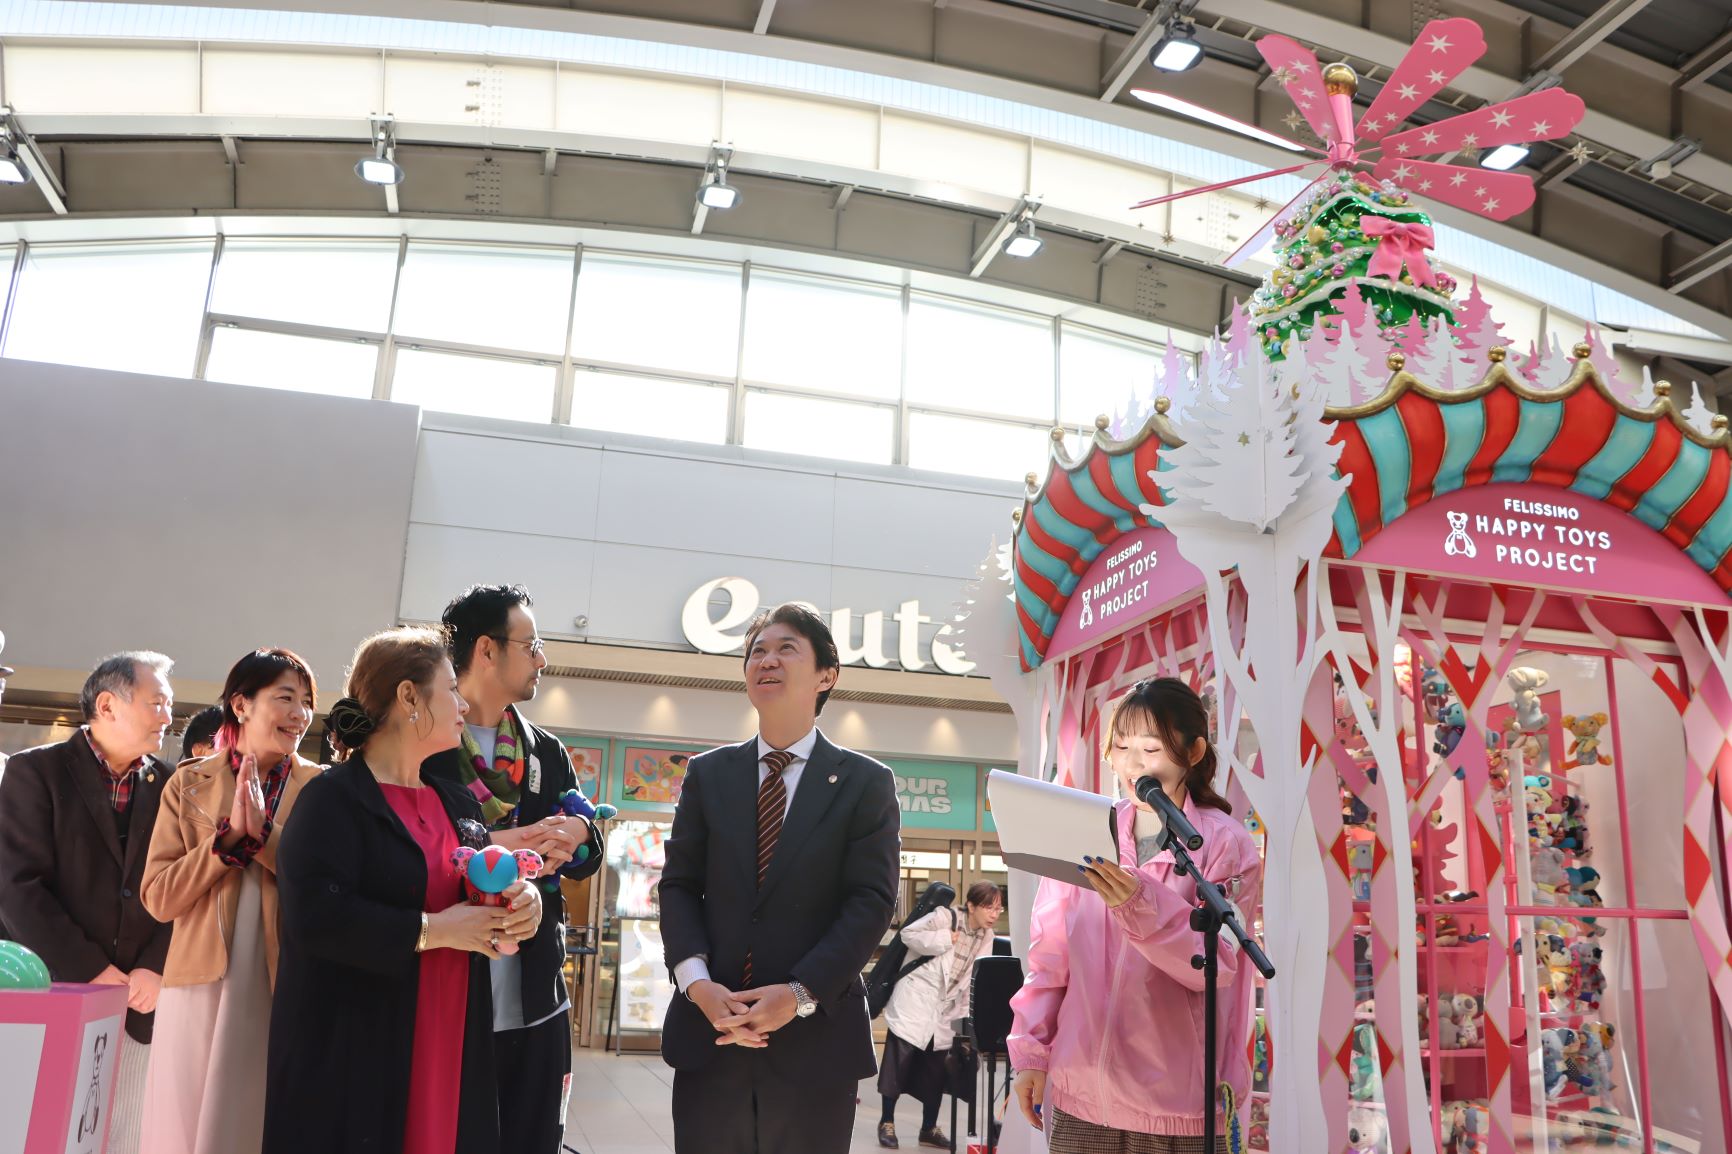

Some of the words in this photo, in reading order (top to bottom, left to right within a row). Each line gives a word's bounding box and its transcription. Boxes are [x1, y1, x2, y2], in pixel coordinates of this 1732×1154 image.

[1504, 498, 1579, 520] FELISSIMO
[1475, 514, 1545, 541] HAPPY
[1554, 526, 1611, 549] TOYS
[1106, 540, 1143, 570] FELISSIMO
[1496, 544, 1597, 574] PROJECT
[1093, 569, 1125, 600] HAPPY
[1129, 551, 1157, 580] TOYS
[1100, 580, 1149, 620] PROJECT
[682, 576, 977, 675] eute
